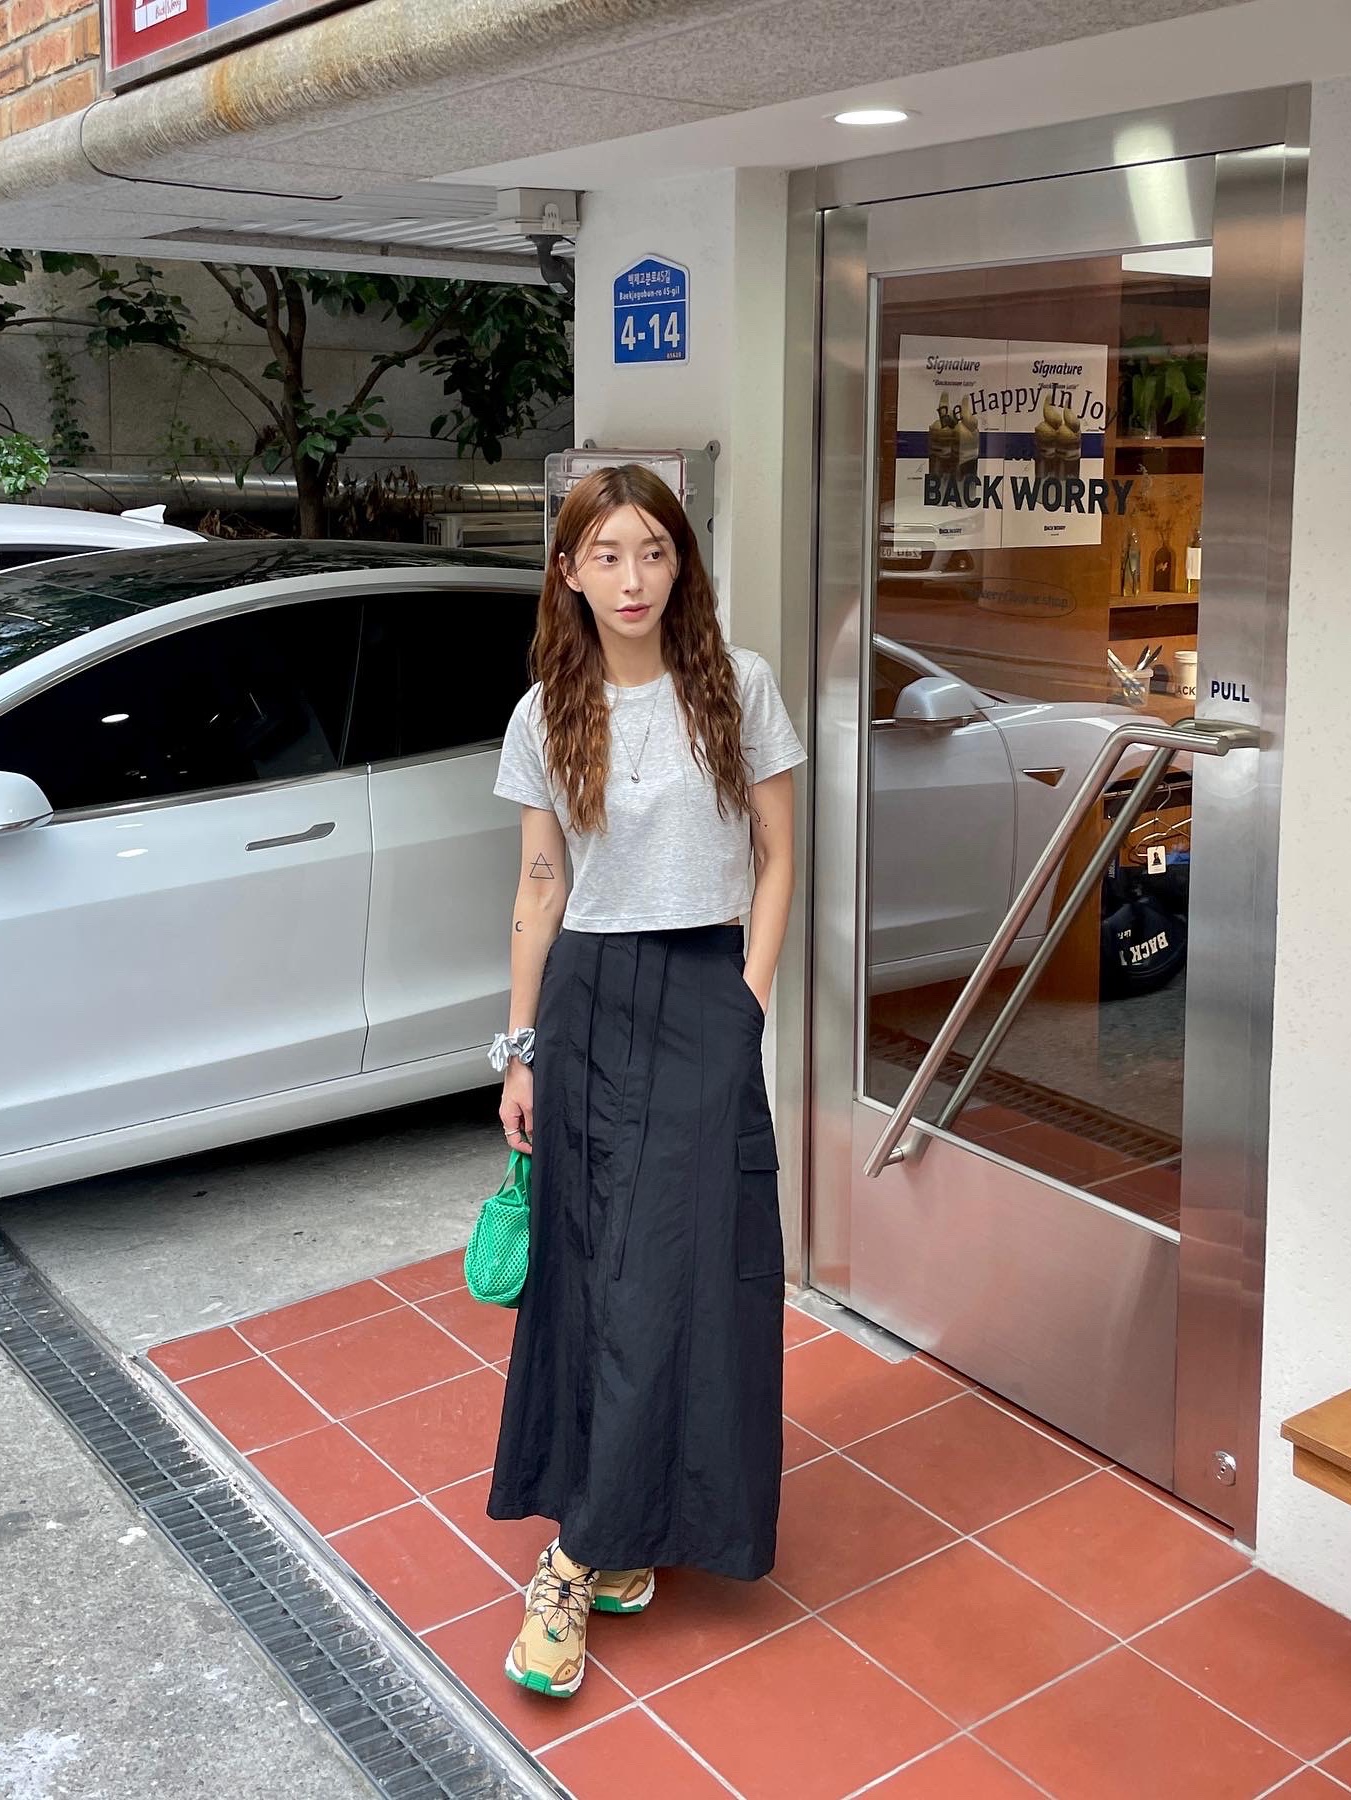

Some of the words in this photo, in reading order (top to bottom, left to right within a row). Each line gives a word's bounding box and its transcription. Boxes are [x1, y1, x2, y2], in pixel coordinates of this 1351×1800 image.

[663, 286, 680, 297] 45-gil
[620, 311, 680, 351] 4-14
[925, 355, 981, 375] Signature
[1032, 360, 1083, 376] Signature
[969, 387, 1042, 416] Happy
[1050, 382, 1073, 410] In
[1077, 390, 1118, 431] Joy
[923, 473, 1004, 510] BACK
[1009, 476, 1135, 516] WORRY
[1210, 680, 1250, 703] PULL
[1129, 931, 1169, 963] BACK
